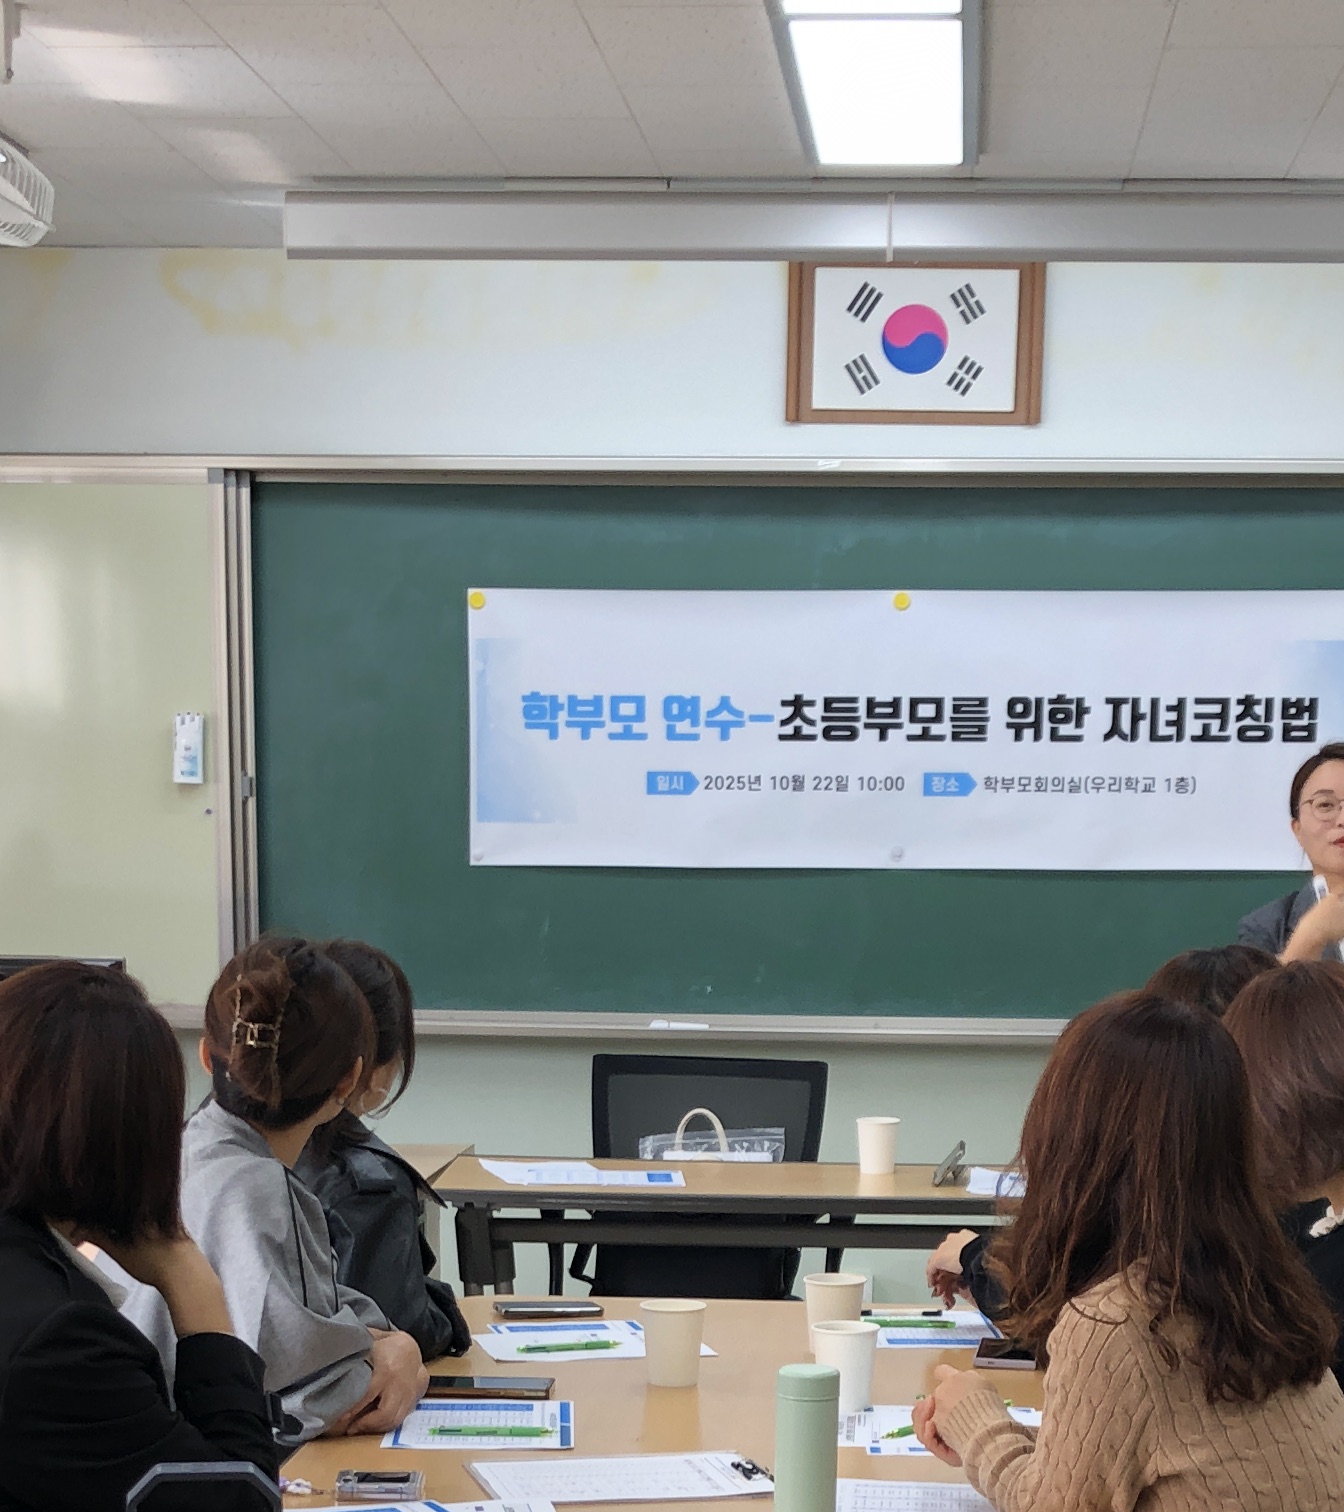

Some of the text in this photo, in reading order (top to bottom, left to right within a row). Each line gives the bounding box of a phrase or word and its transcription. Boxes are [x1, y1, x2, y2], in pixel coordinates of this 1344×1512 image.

[521, 691, 648, 742] 학부모
[1005, 693, 1092, 743] 위한
[1102, 693, 1320, 744] 자녀코칭법
[656, 774, 906, 793] 일시 2025년 10월 22일 10:00
[931, 776, 1198, 794] 장소 학부모회의실(우리학교 1층)
